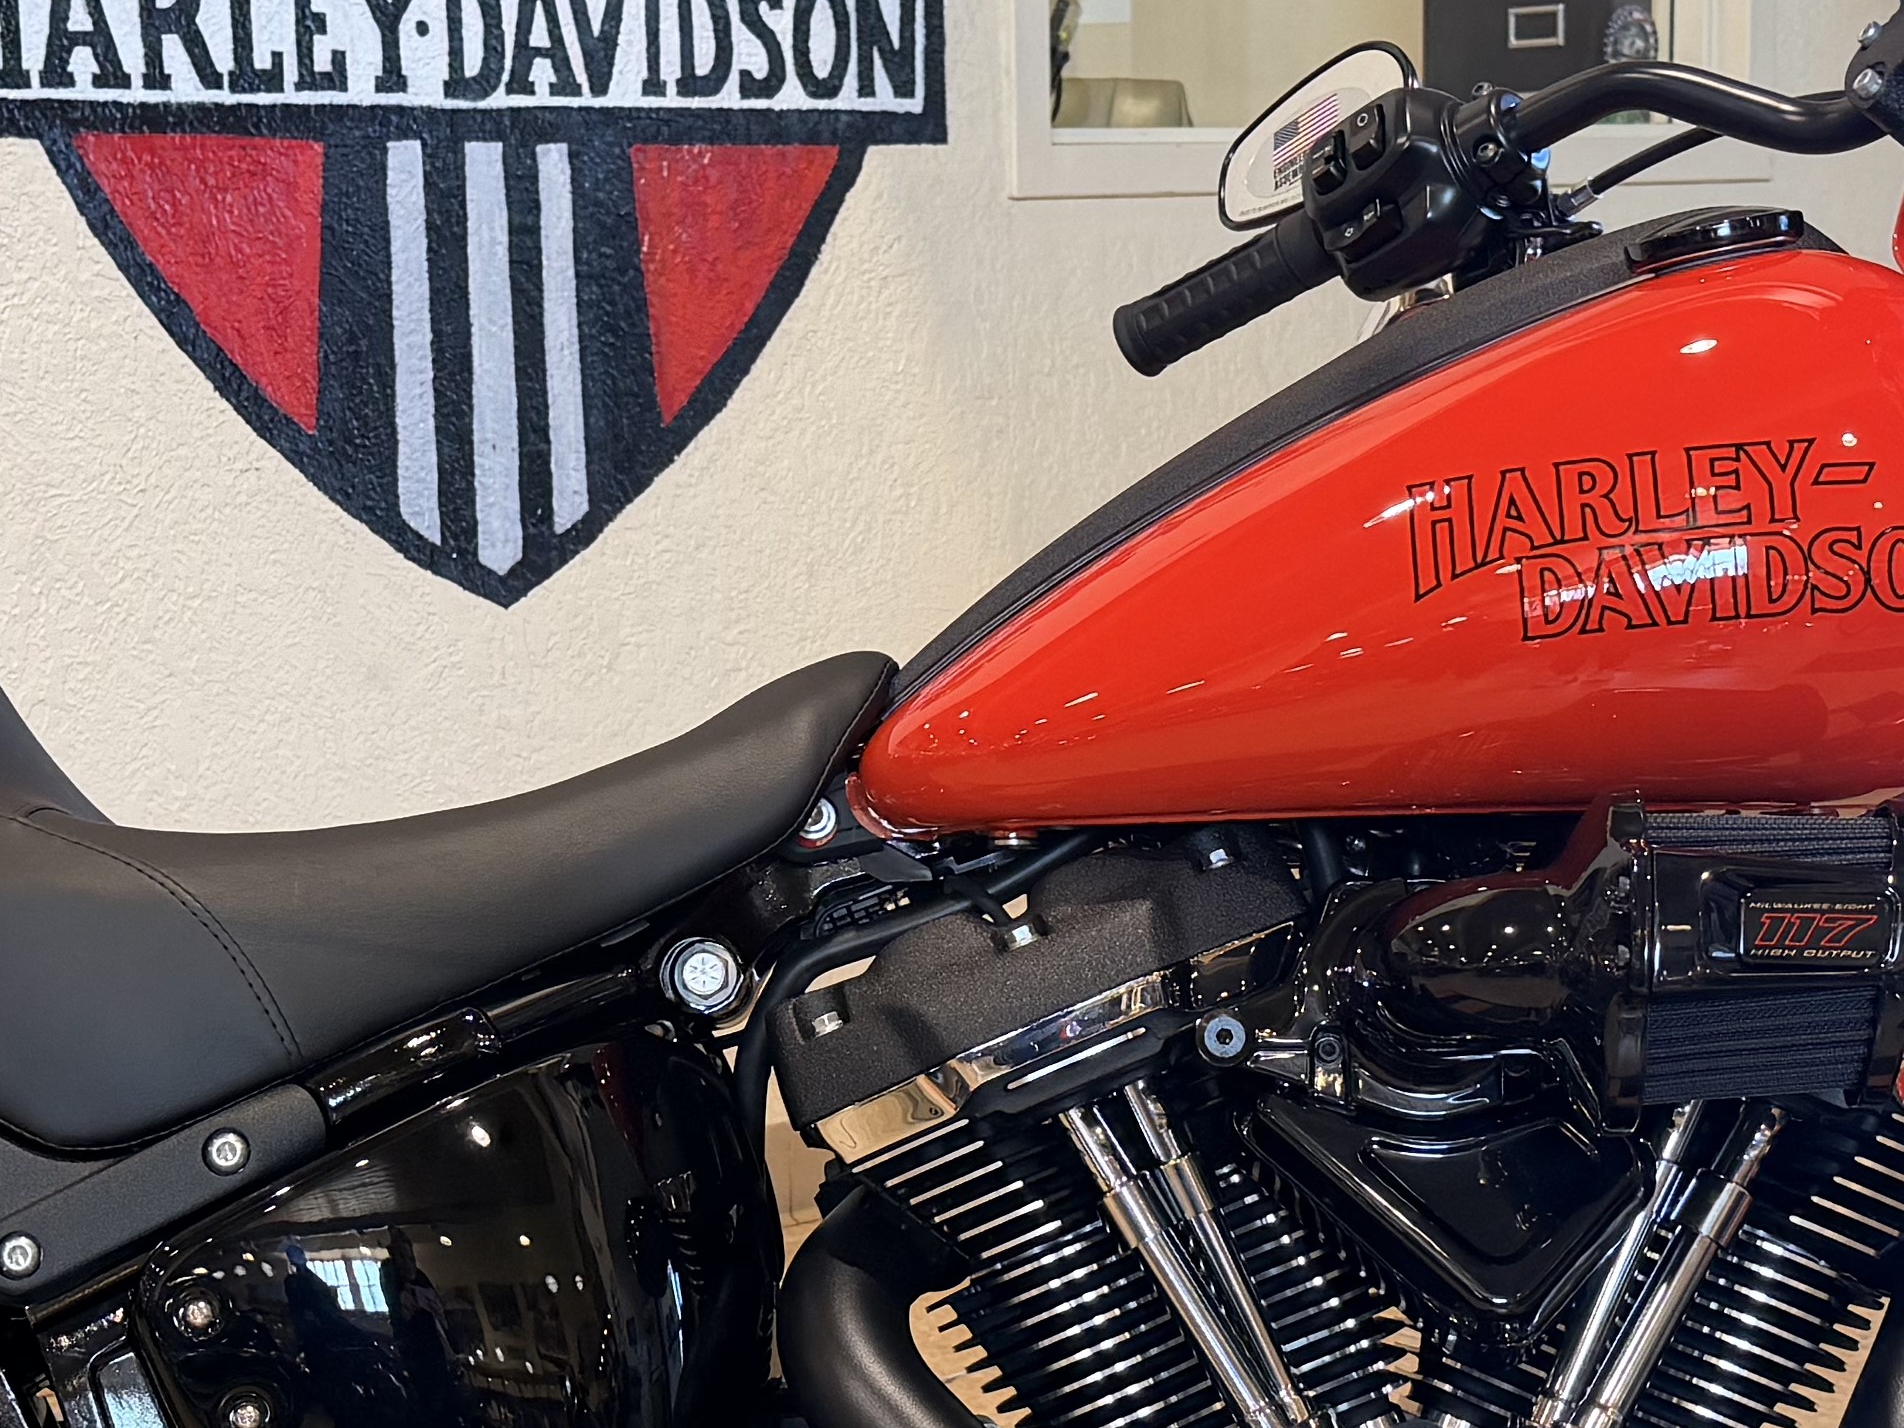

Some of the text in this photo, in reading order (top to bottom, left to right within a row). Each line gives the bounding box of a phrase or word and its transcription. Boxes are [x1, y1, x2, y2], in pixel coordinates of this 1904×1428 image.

[1406, 438, 1876, 603] HARLEY-
[1754, 913, 1879, 947] 117
[1749, 948, 1876, 959] HIGH OUTPUT
